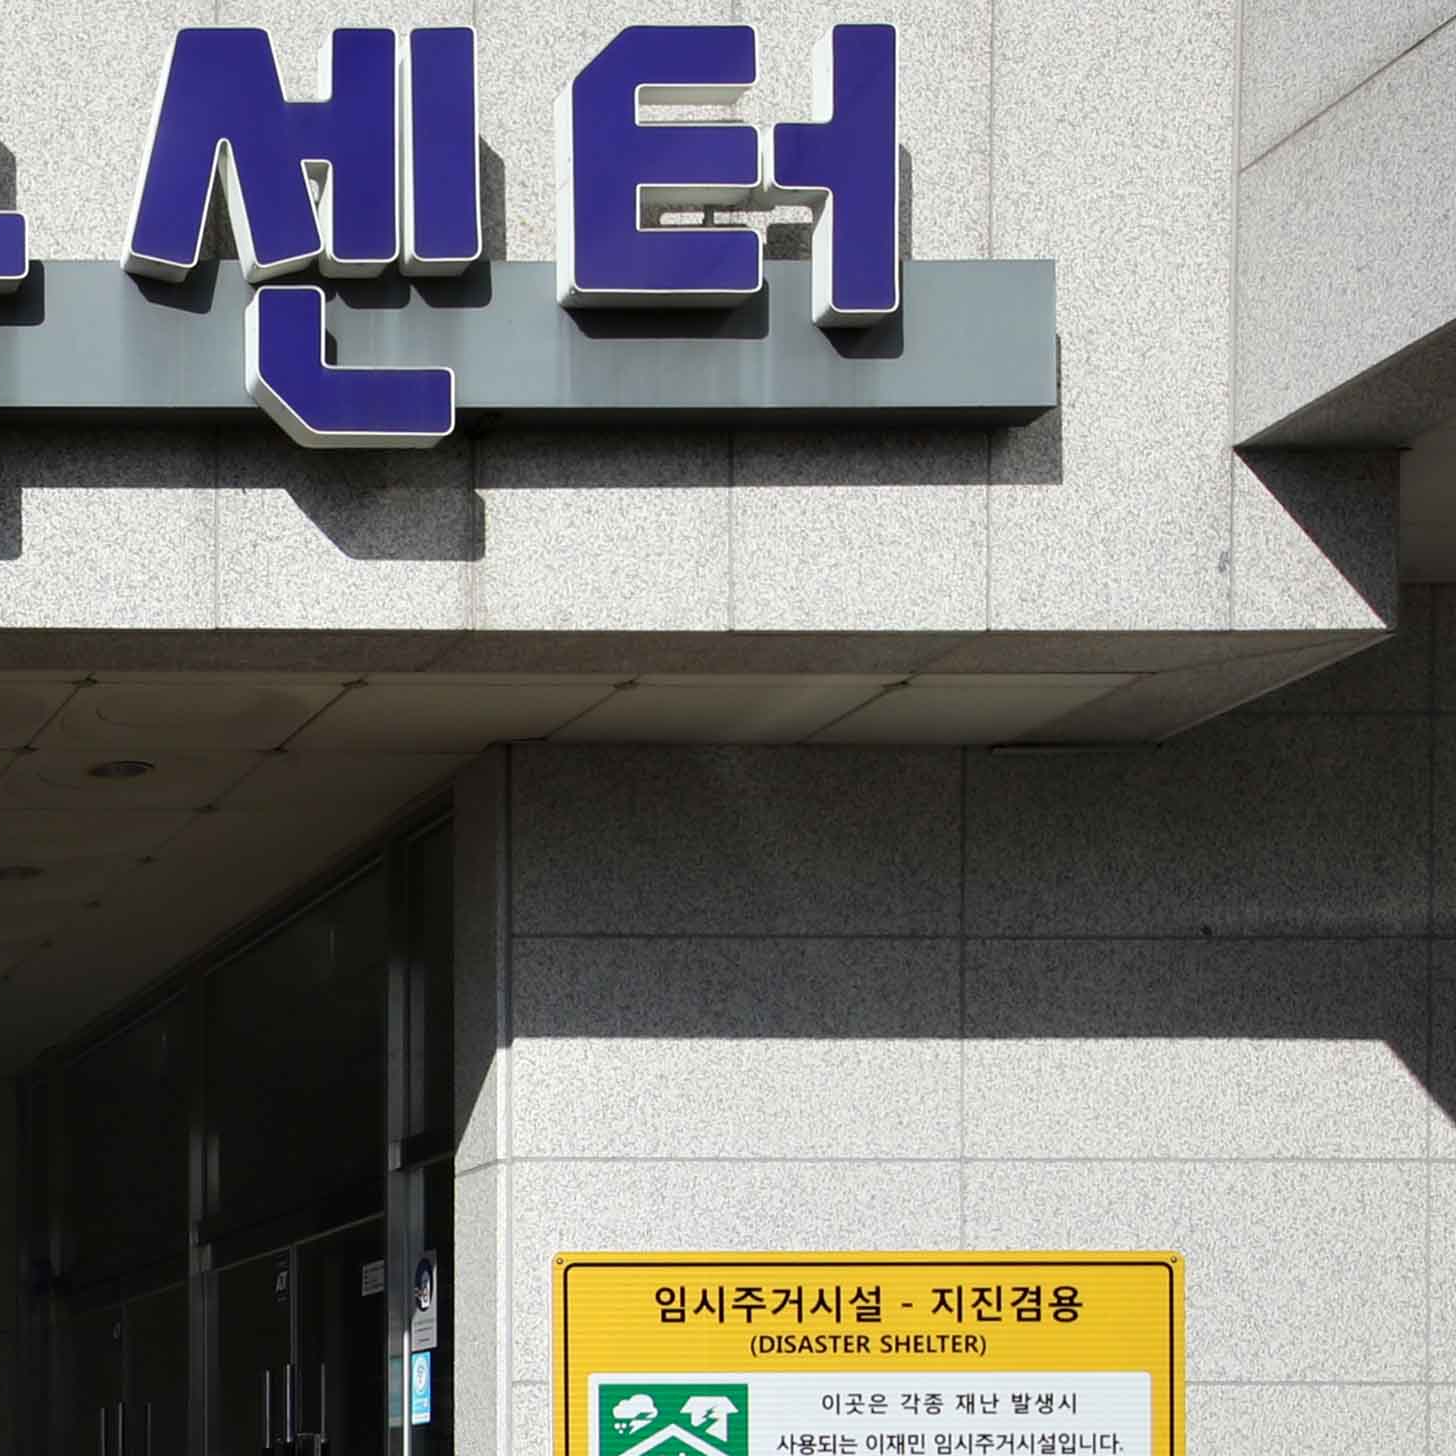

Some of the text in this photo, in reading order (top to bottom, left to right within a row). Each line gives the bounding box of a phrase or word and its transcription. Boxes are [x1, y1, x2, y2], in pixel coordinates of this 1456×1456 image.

[654, 1284, 884, 1324] 임시주거시설
[931, 1284, 1085, 1324] 지진겸용
[749, 1333, 987, 1358] (DISASTER SHELTER)
[821, 1391, 1079, 1416] 이곳은 각종 재난 발생시
[776, 1434, 1125, 1456] 사용되는 이재민 임시주거시설입니다.
